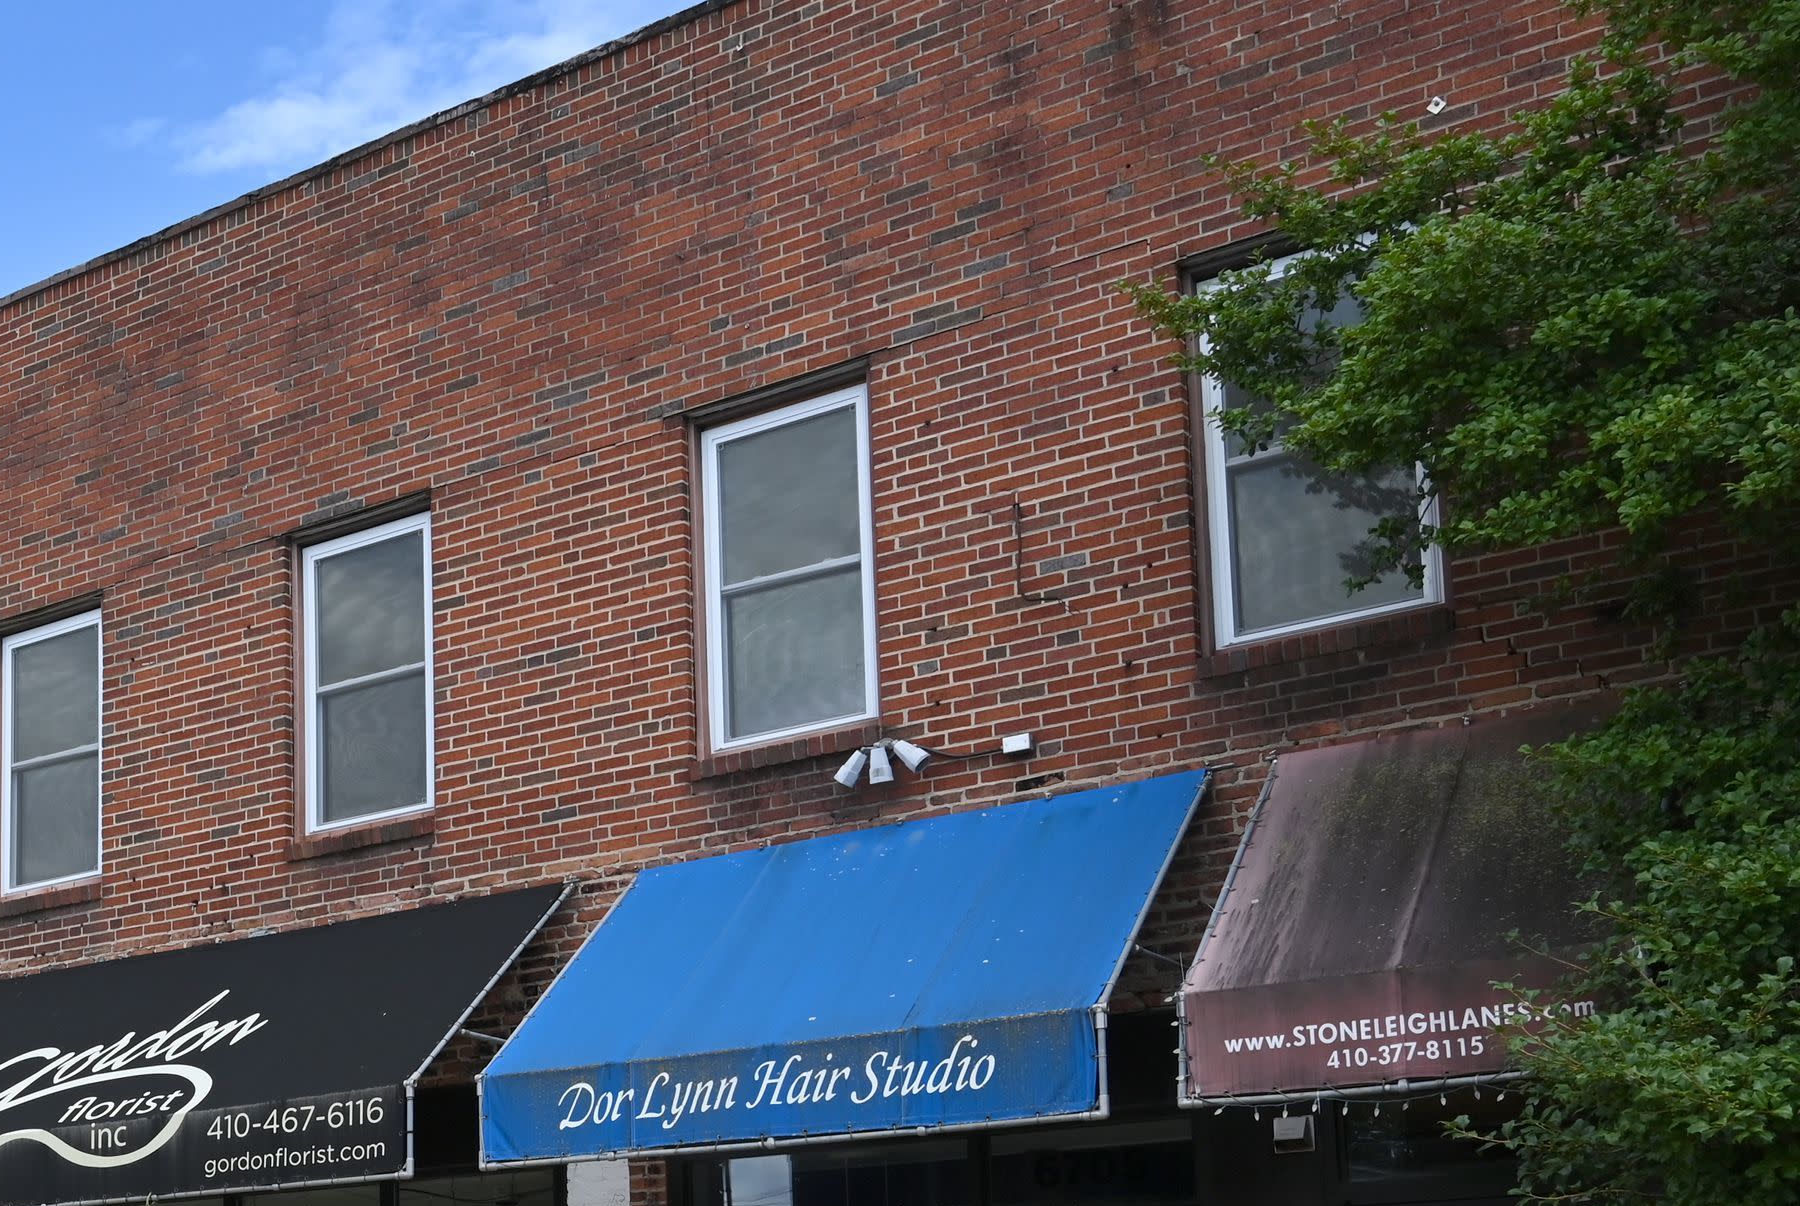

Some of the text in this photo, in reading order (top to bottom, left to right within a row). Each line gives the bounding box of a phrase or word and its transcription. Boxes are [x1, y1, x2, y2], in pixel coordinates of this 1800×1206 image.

[1326, 1035, 1484, 1069] 410-377-8115
[558, 1034, 997, 1131] Dor Lynn Hair Studio
[58, 1089, 186, 1125] florist
[207, 1097, 385, 1142] 410-467-6116
[89, 1123, 128, 1150] inc
[203, 1138, 386, 1178] gordonflorist.com
